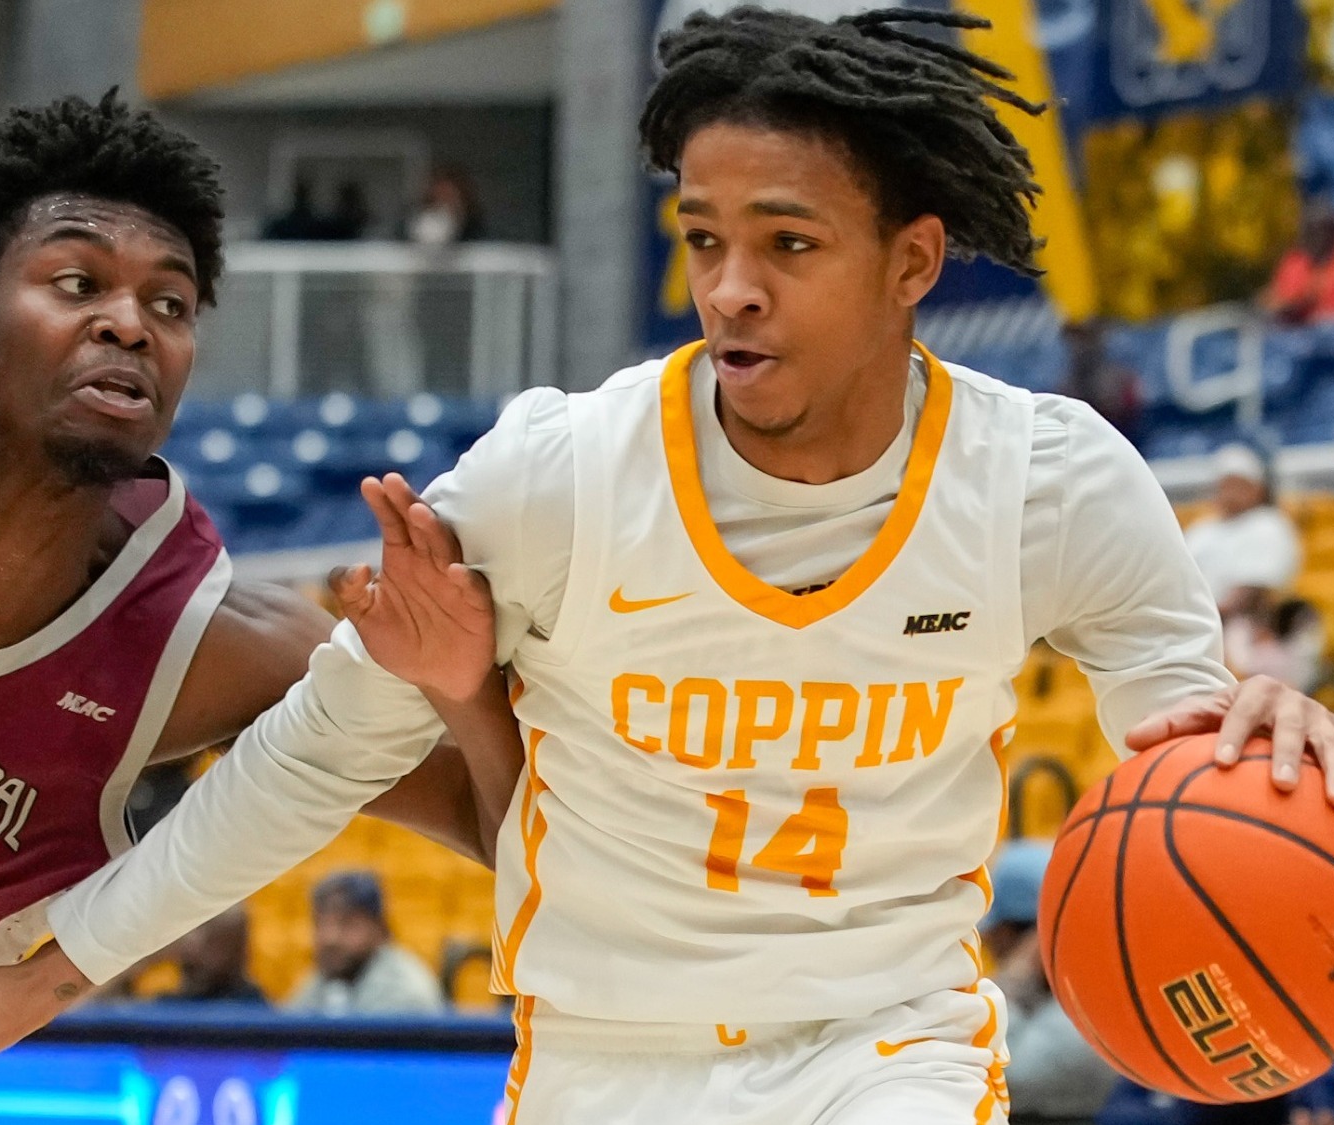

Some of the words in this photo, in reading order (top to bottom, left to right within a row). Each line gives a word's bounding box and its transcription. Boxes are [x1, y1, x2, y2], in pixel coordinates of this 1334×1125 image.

[903, 611, 971, 637] MEAC
[57, 691, 115, 724] MEAC
[611, 672, 964, 770] COPPIN
[706, 787, 849, 898] 14
[1160, 969, 1295, 1097] ELITE
